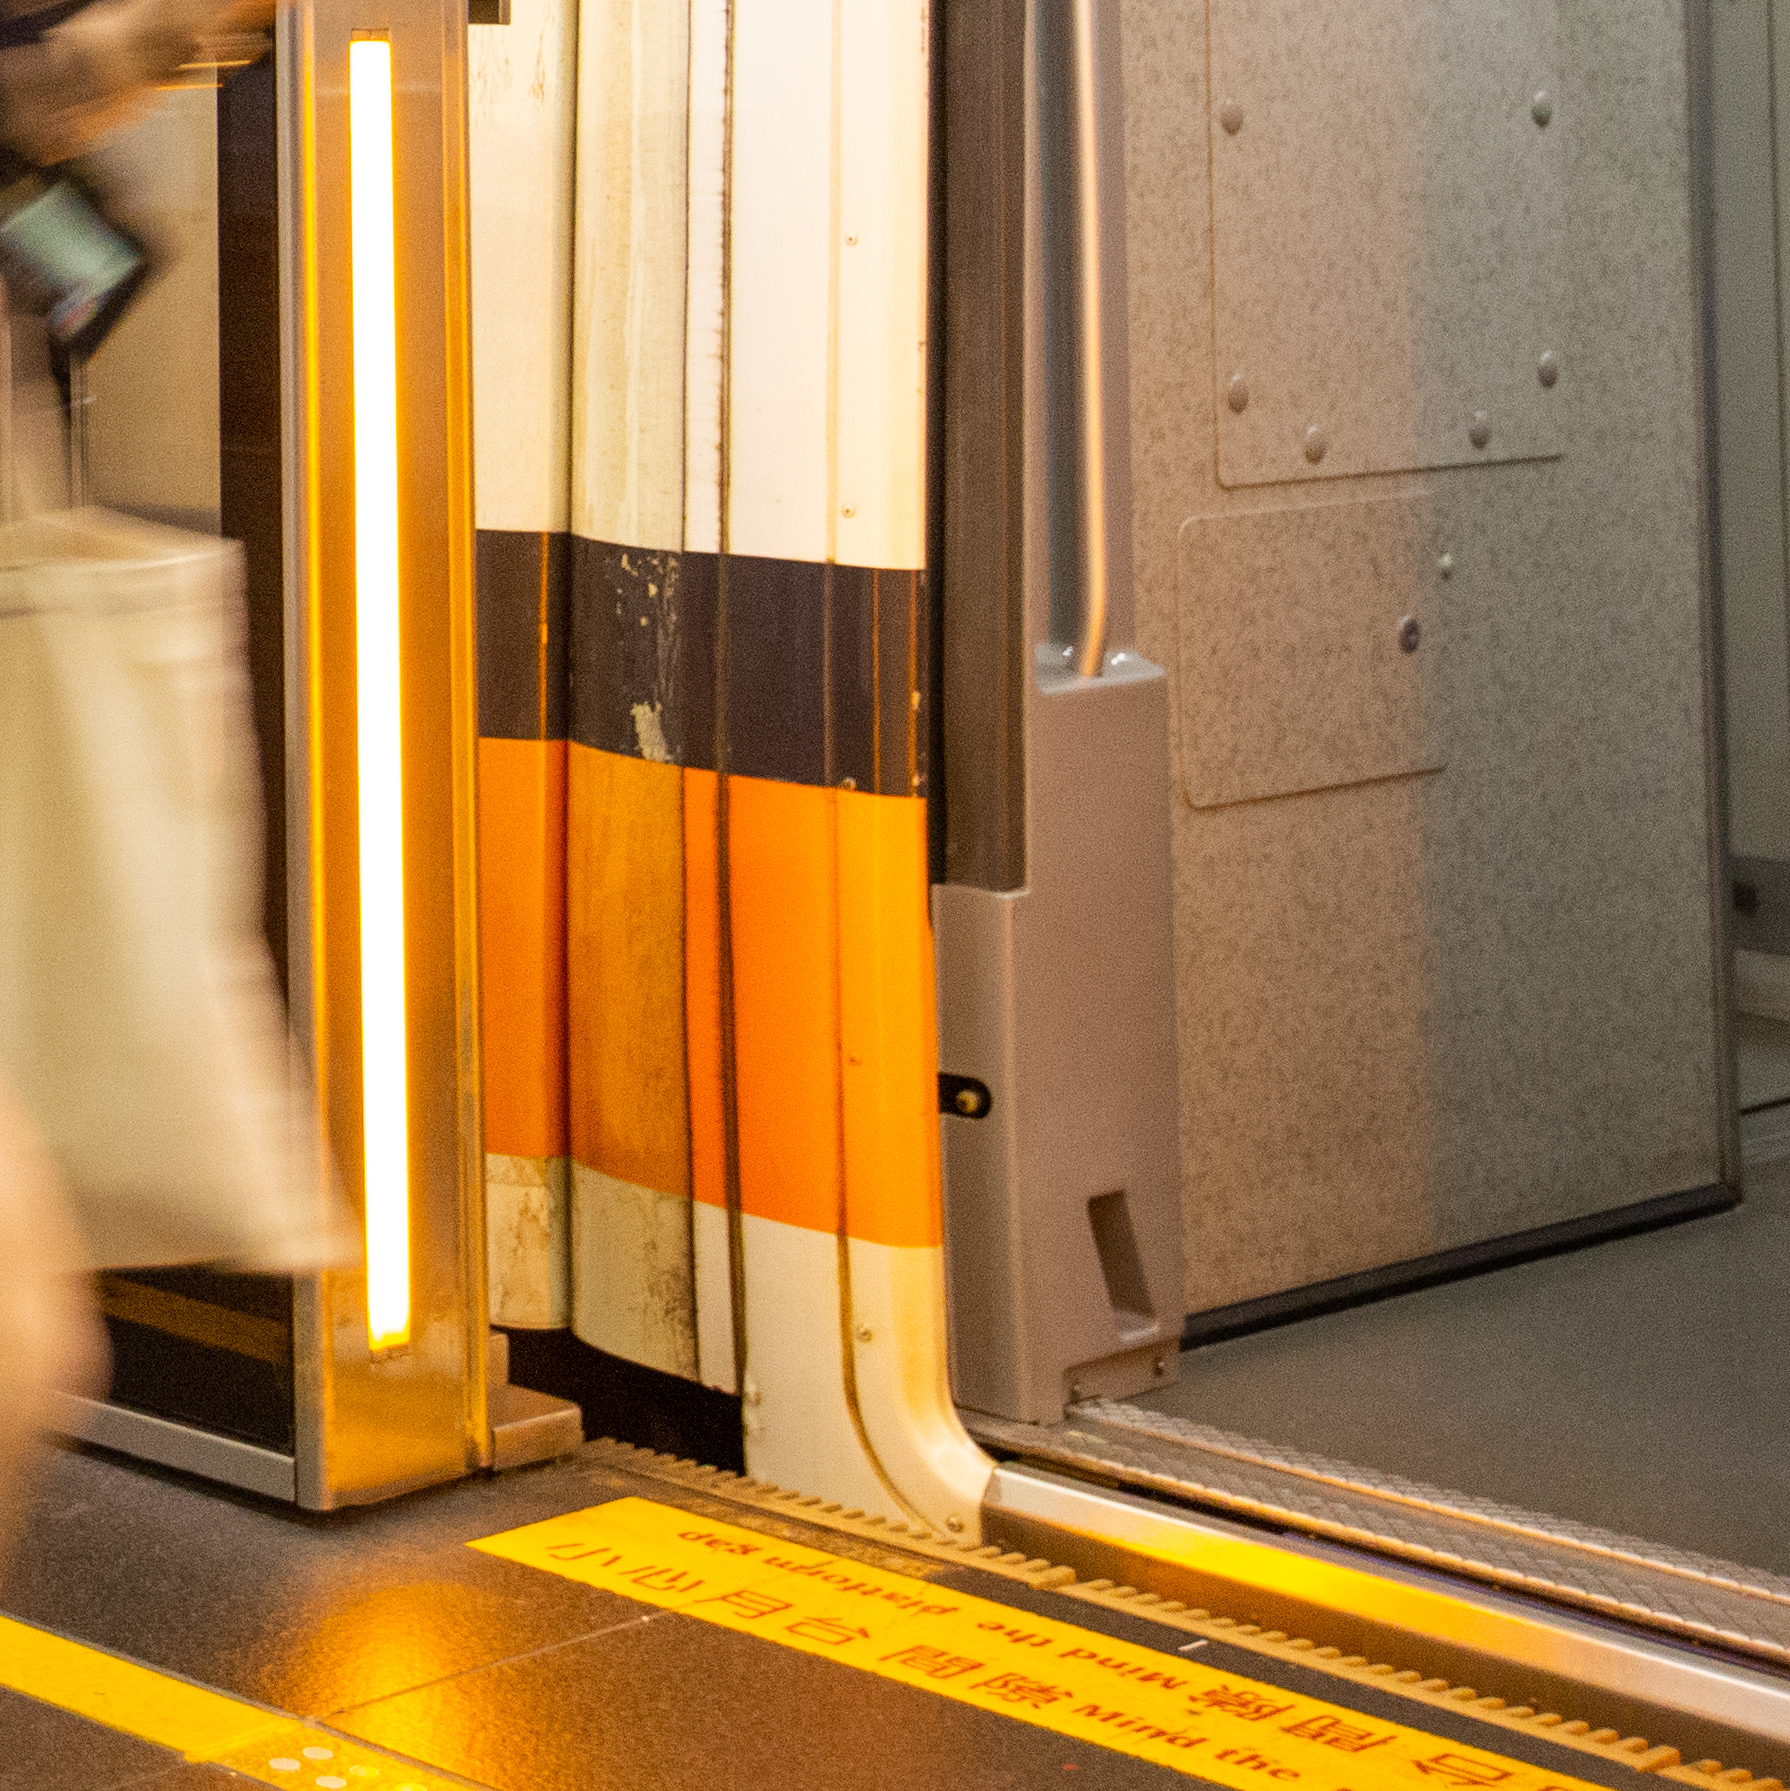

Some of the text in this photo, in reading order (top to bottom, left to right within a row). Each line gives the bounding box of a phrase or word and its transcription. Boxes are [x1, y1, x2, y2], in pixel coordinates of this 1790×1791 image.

[762, 1555, 962, 1617] platform
[976, 1620, 1053, 1649] the
[1059, 1645, 1189, 1691] Mind
[1071, 1701, 1209, 1751] Mind
[1215, 1747, 1301, 1782] the
[1188, 1683, 1574, 1791] 台間隙
